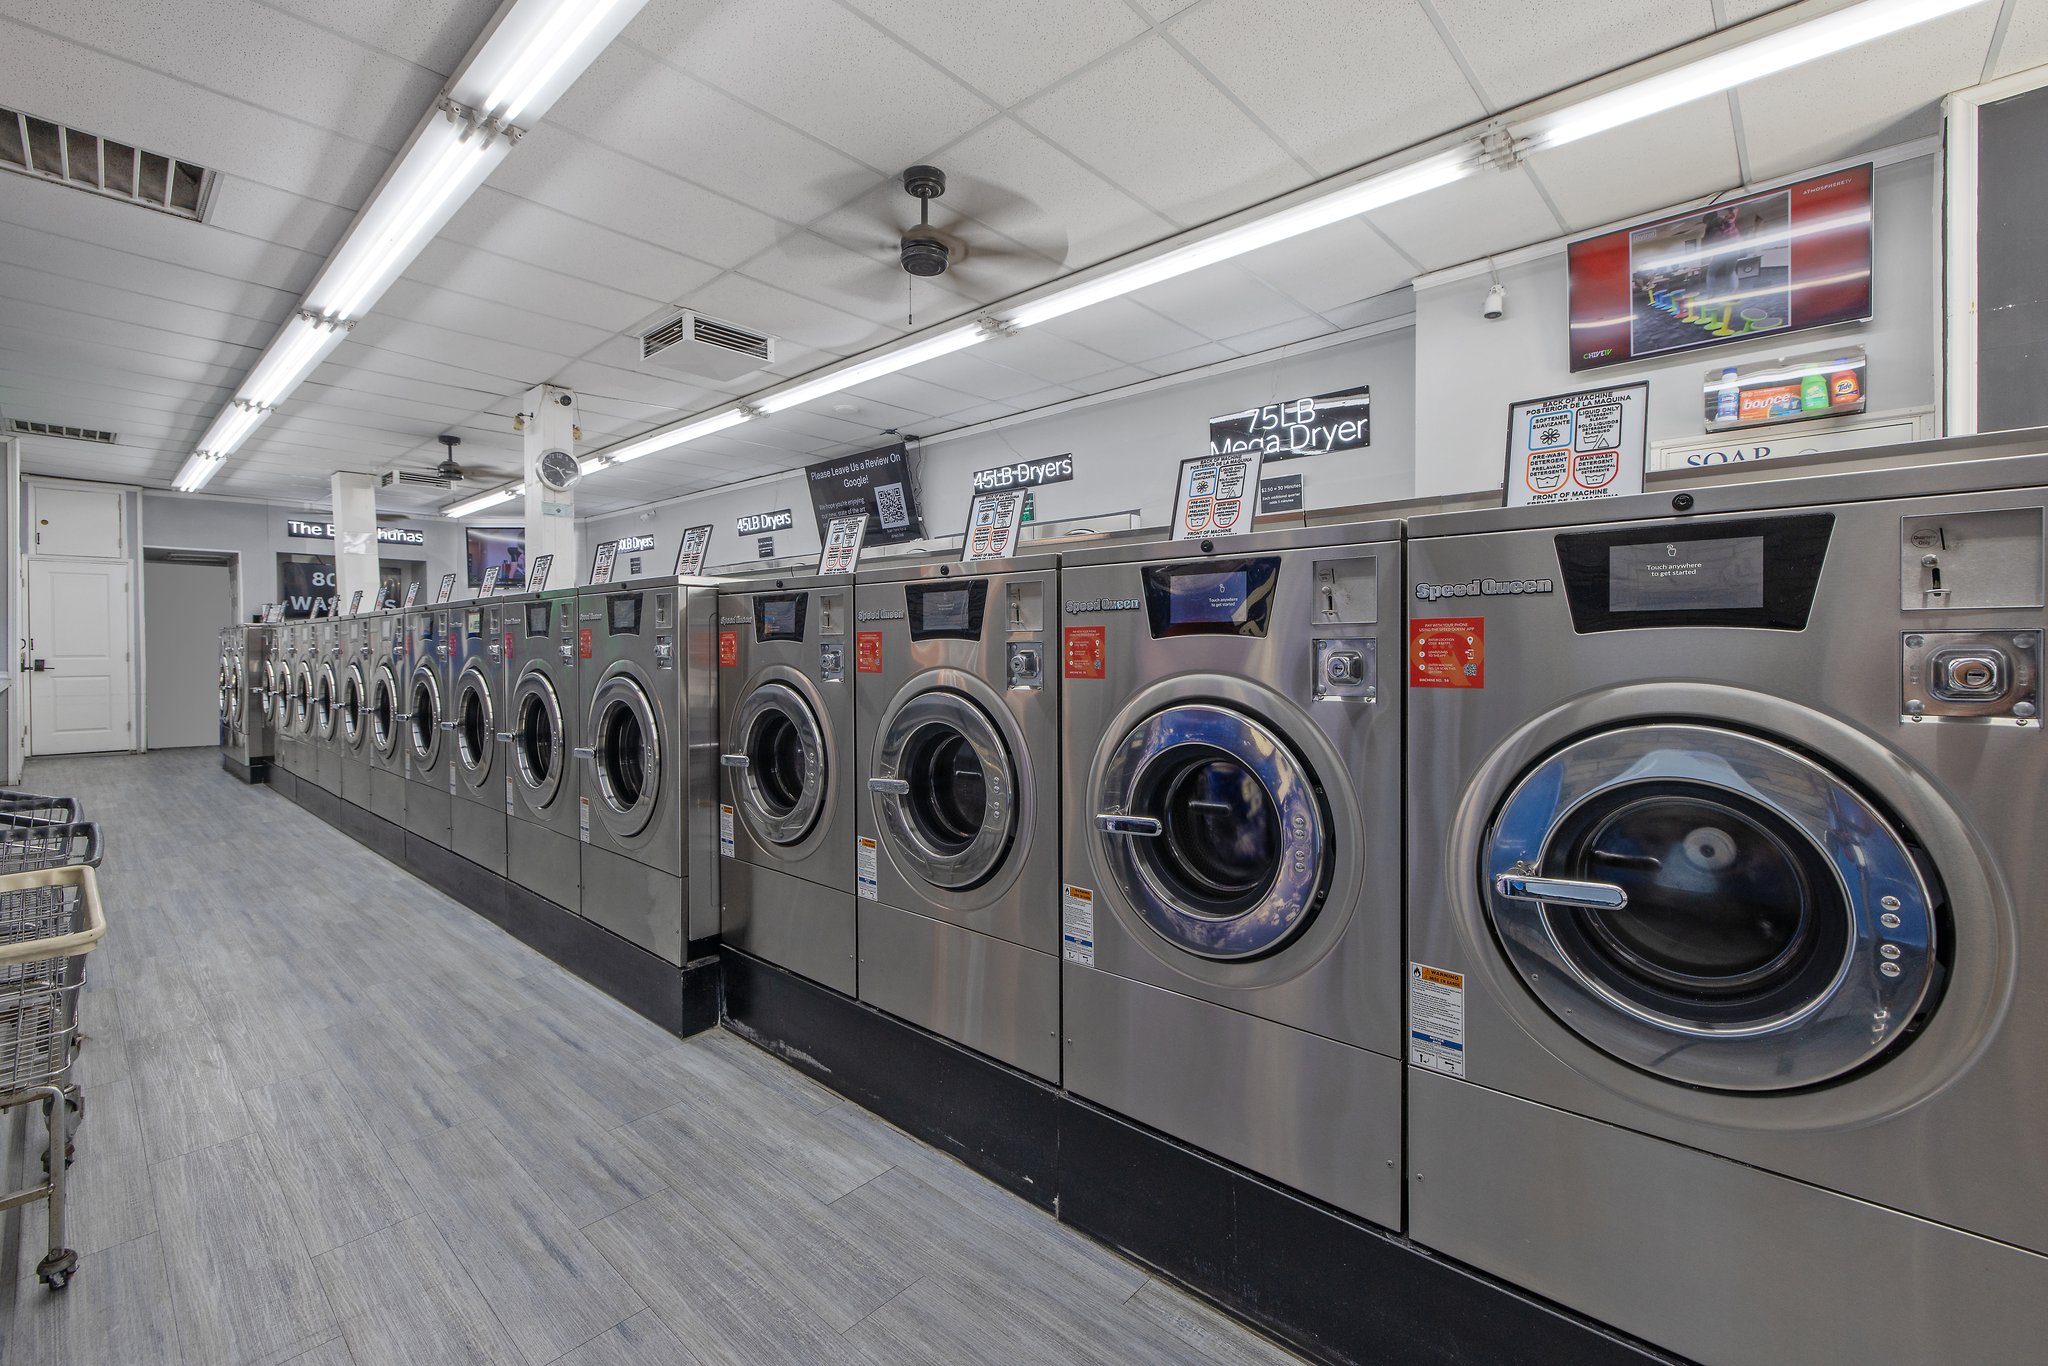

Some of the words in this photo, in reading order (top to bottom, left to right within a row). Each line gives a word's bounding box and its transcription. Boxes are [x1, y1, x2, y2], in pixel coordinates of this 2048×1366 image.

[1838, 383, 1852, 392] Tide
[1526, 404, 1568, 416] POSTERIOR
[1594, 395, 1632, 405] MAQUINA
[1543, 399, 1564, 408] BACK
[1578, 392, 1613, 403] MACHINE
[1744, 394, 1791, 410] bounce
[1248, 398, 1316, 433] 75LB
[1579, 408, 1601, 416] LIQUID
[1602, 405, 1620, 413] ONLY
[1532, 420, 1570, 430] SUAVIZANTE
[1535, 414, 1568, 424] SOFTENER
[1290, 418, 1369, 451] Dryer
[1530, 457, 1567, 466] DETERGENT
[1532, 452, 1566, 460] PRE-WASH
[1578, 458, 1613, 467] DETERGENT
[811, 470, 831, 481] Please
[831, 465, 850, 476] Leave
[850, 462, 859, 472] Us
[860, 462, 864, 470] a
[865, 456, 889, 469] Review
[890, 453, 901, 463] On
[974, 466, 1012, 489] 45LB
[1017, 458, 1072, 484] Dryers
[1530, 468, 1566, 477] DETERGENTE
[1532, 464, 1565, 472] PRELAVADO
[844, 474, 869, 488] Google!
[1532, 493, 1558, 501] FRONT
[1572, 488, 1608, 497] MACHINE
[288, 520, 322, 535] The
[737, 516, 760, 532] 45LB
[761, 512, 792, 530] Dryers
[632, 537, 654, 550] Dryers
[1668, 562, 1702, 570] anywhere
[1660, 570, 1672, 578] get
[1672, 568, 1696, 576] started
[1416, 580, 1480, 601] Speed
[1480, 578, 1553, 596] Queen
[1066, 598, 1100, 615] Speed
[1100, 598, 1140, 611] Queen
[858, 610, 880, 622] Speed
[880, 608, 904, 620] Queen
[1430, 970, 1458, 980] WARNING
